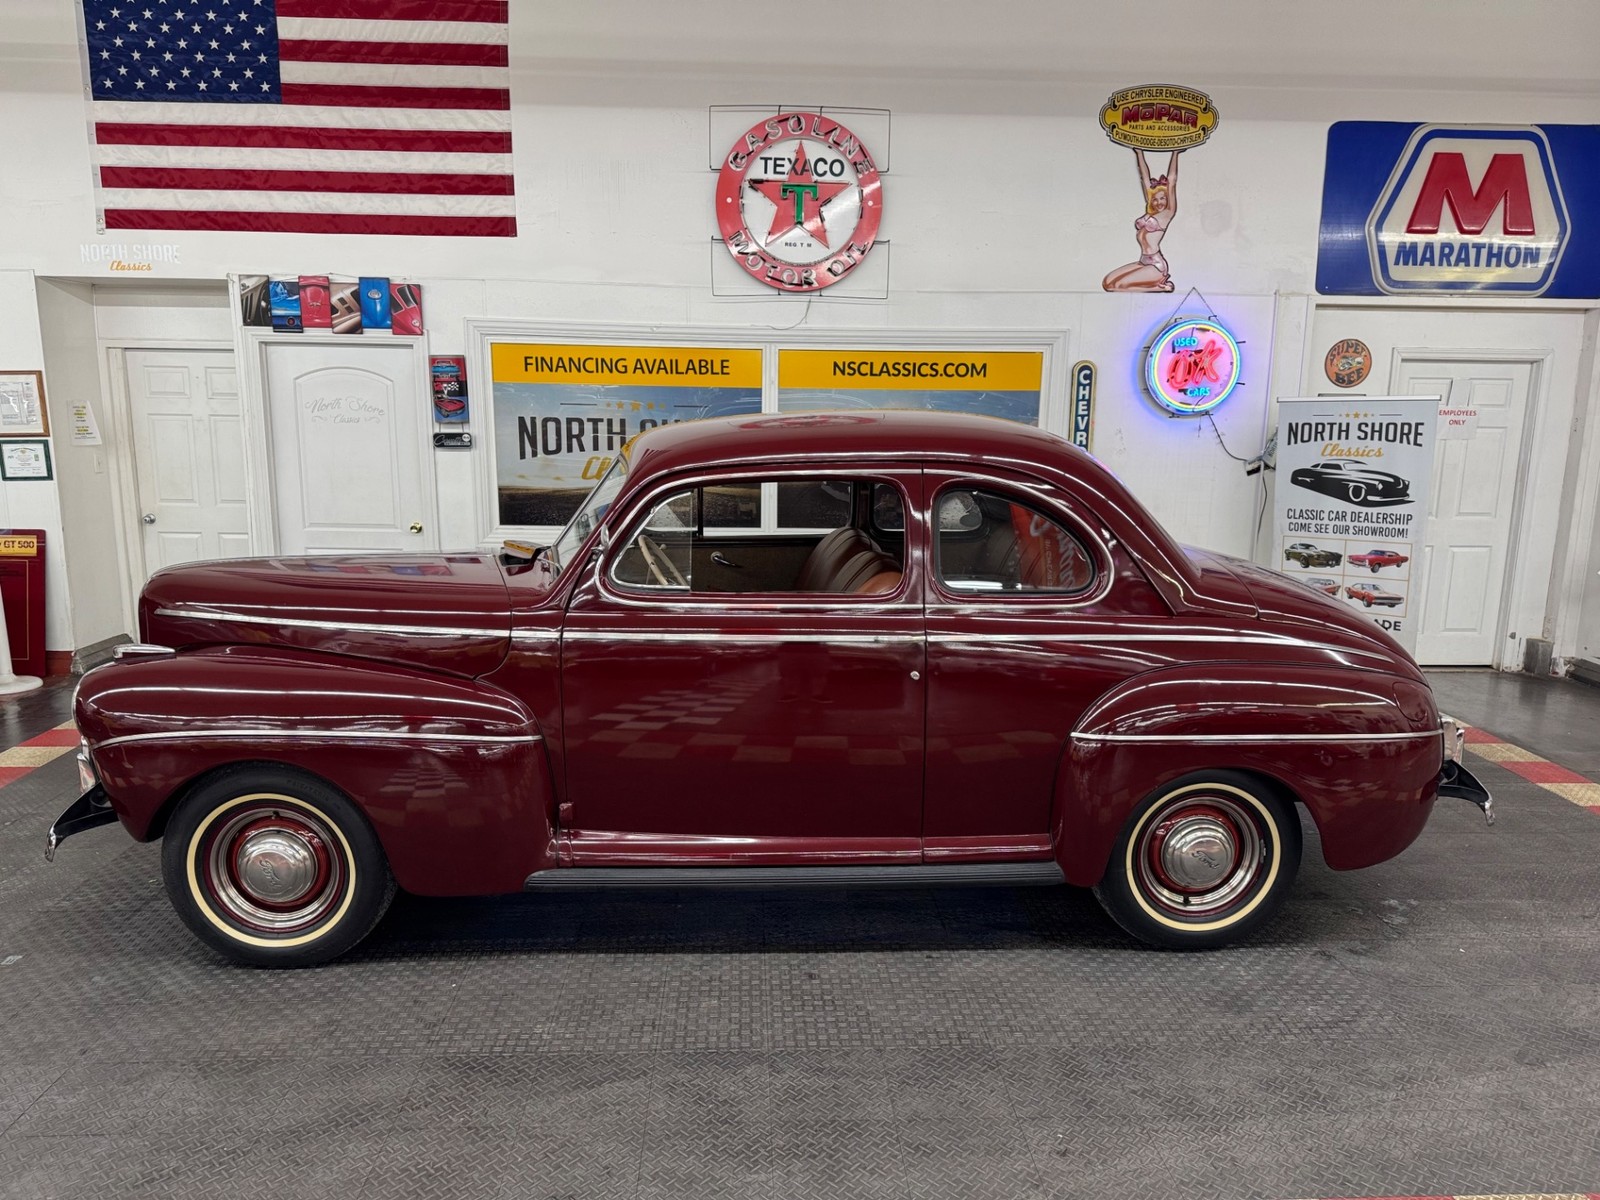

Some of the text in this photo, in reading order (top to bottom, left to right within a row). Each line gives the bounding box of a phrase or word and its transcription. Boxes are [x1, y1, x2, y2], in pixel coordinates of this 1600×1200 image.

[1117, 89, 1204, 104] USE CHRYSLER ENGINEERED
[1122, 103, 1198, 128] MOPAR
[728, 114, 875, 179] GASOLINE
[760, 156, 845, 178] TEXACO
[1405, 152, 1536, 236] M
[780, 182, 819, 227] T
[729, 230, 870, 288] MOTOR OIL
[1394, 241, 1542, 268] MARATHON
[1173, 336, 1198, 347] USED
[523, 356, 731, 376] FINANCING AVAILABLE
[832, 360, 988, 379] NSCLASSICS.COM
[1335, 367, 1364, 385] BEE
[1186, 386, 1211, 397] CARS
[304, 396, 385, 416] North Shore
[1075, 369, 1092, 451] CHEVR
[517, 415, 627, 460] NORTH
[1286, 421, 1426, 448] NORTH SHORE
[1320, 443, 1384, 458] Classics
[1286, 508, 1413, 526] CLASSIC CAR DEALERSHIP
[1288, 521, 1409, 539] COME SEE OUR SHOWROOM!
[3, 540, 17, 549] GT
[17, 540, 35, 549] 500
[1190, 850, 1220, 870] Ford
